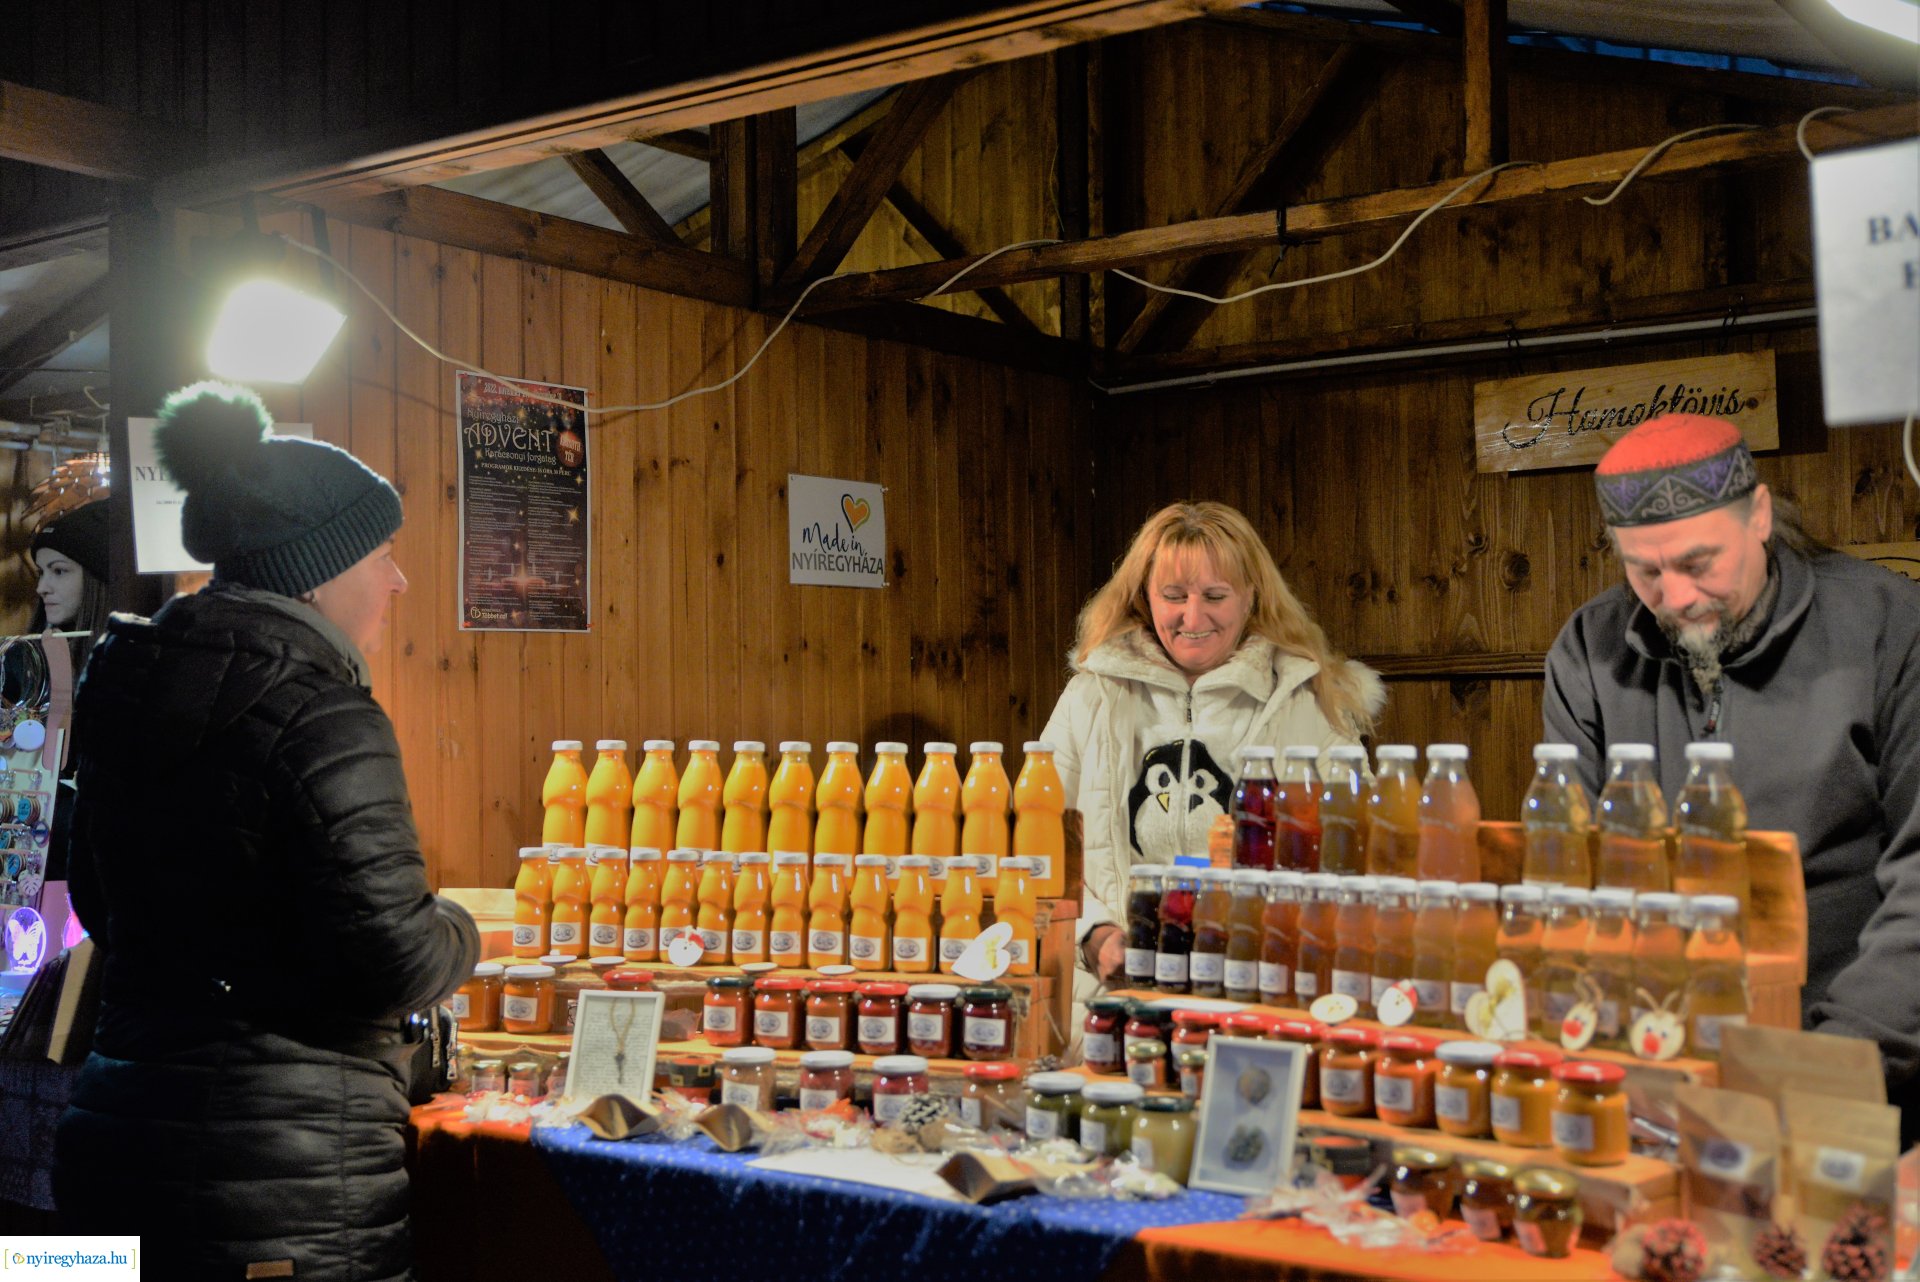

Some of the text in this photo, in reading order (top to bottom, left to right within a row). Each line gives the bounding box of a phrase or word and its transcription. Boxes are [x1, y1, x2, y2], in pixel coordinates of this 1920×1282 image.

[464, 422, 553, 452] ADVENT
[802, 522, 866, 557] Made in
[792, 550, 884, 575] NYÍREGYHÁZA
